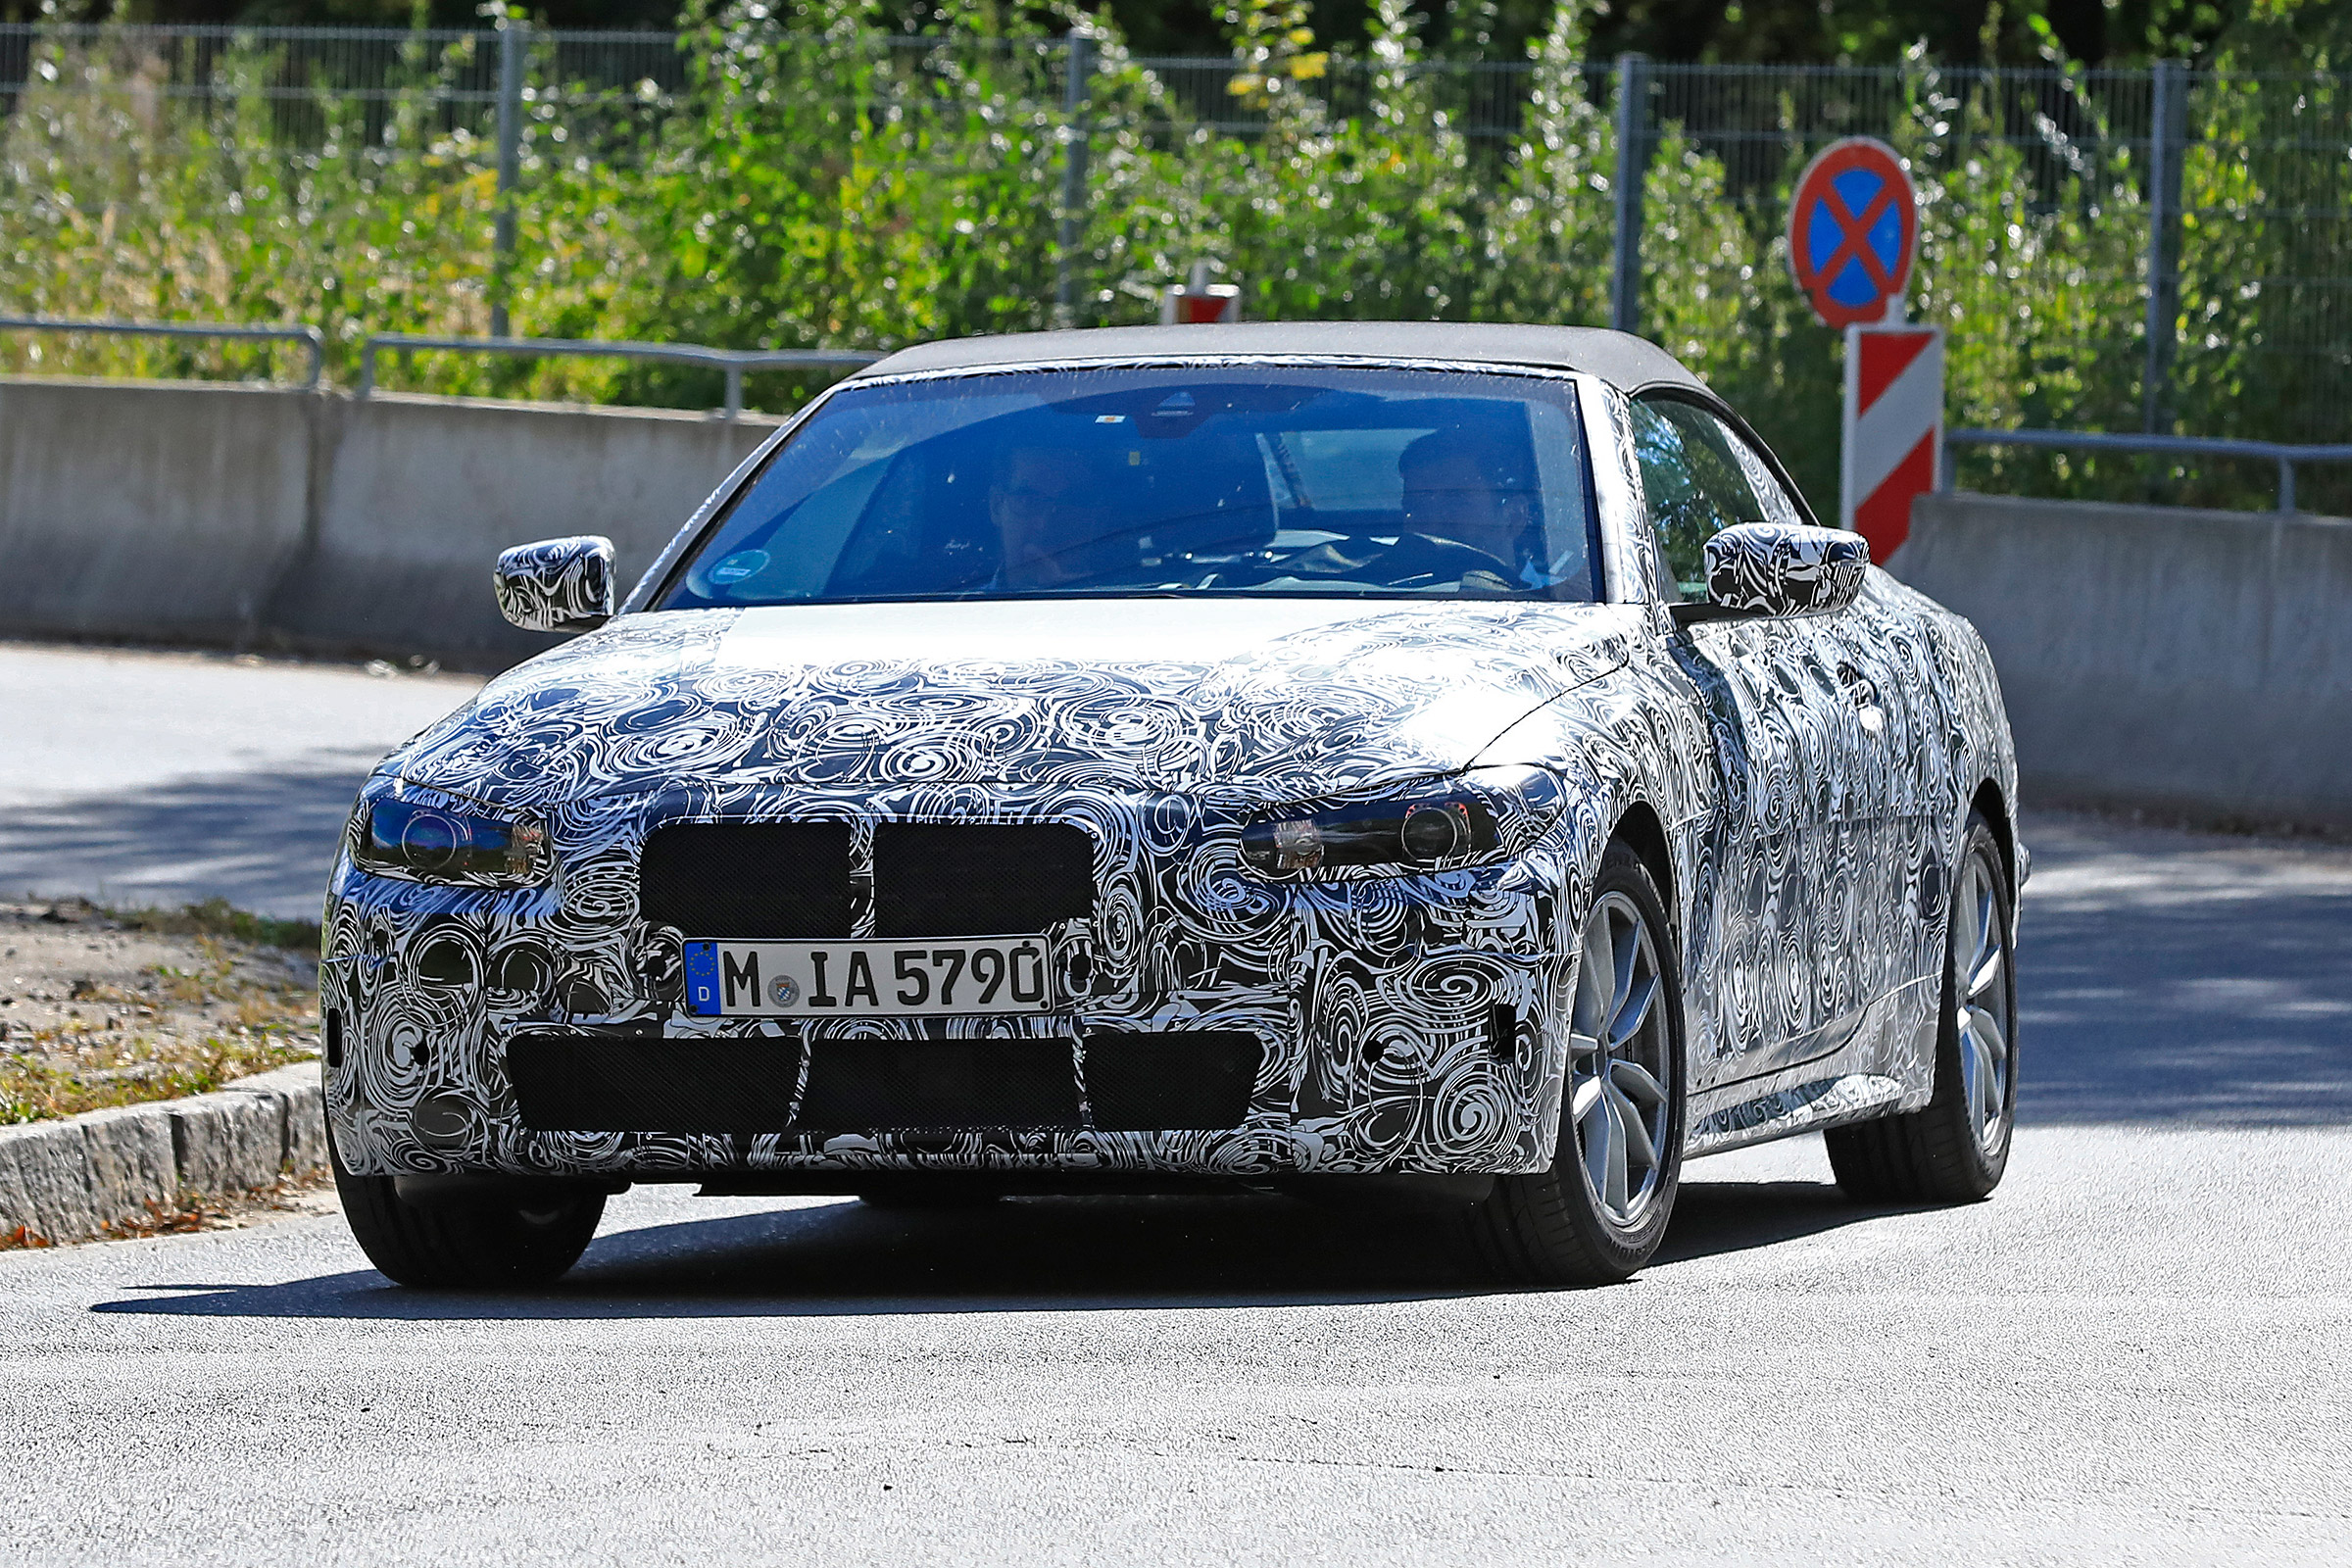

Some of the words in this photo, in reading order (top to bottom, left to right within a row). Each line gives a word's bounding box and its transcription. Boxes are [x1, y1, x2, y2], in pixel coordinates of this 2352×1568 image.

[698, 986, 710, 1002] D
[723, 951, 760, 1007] M
[808, 951, 879, 1007] IA
[894, 947, 1045, 1005] 5790
